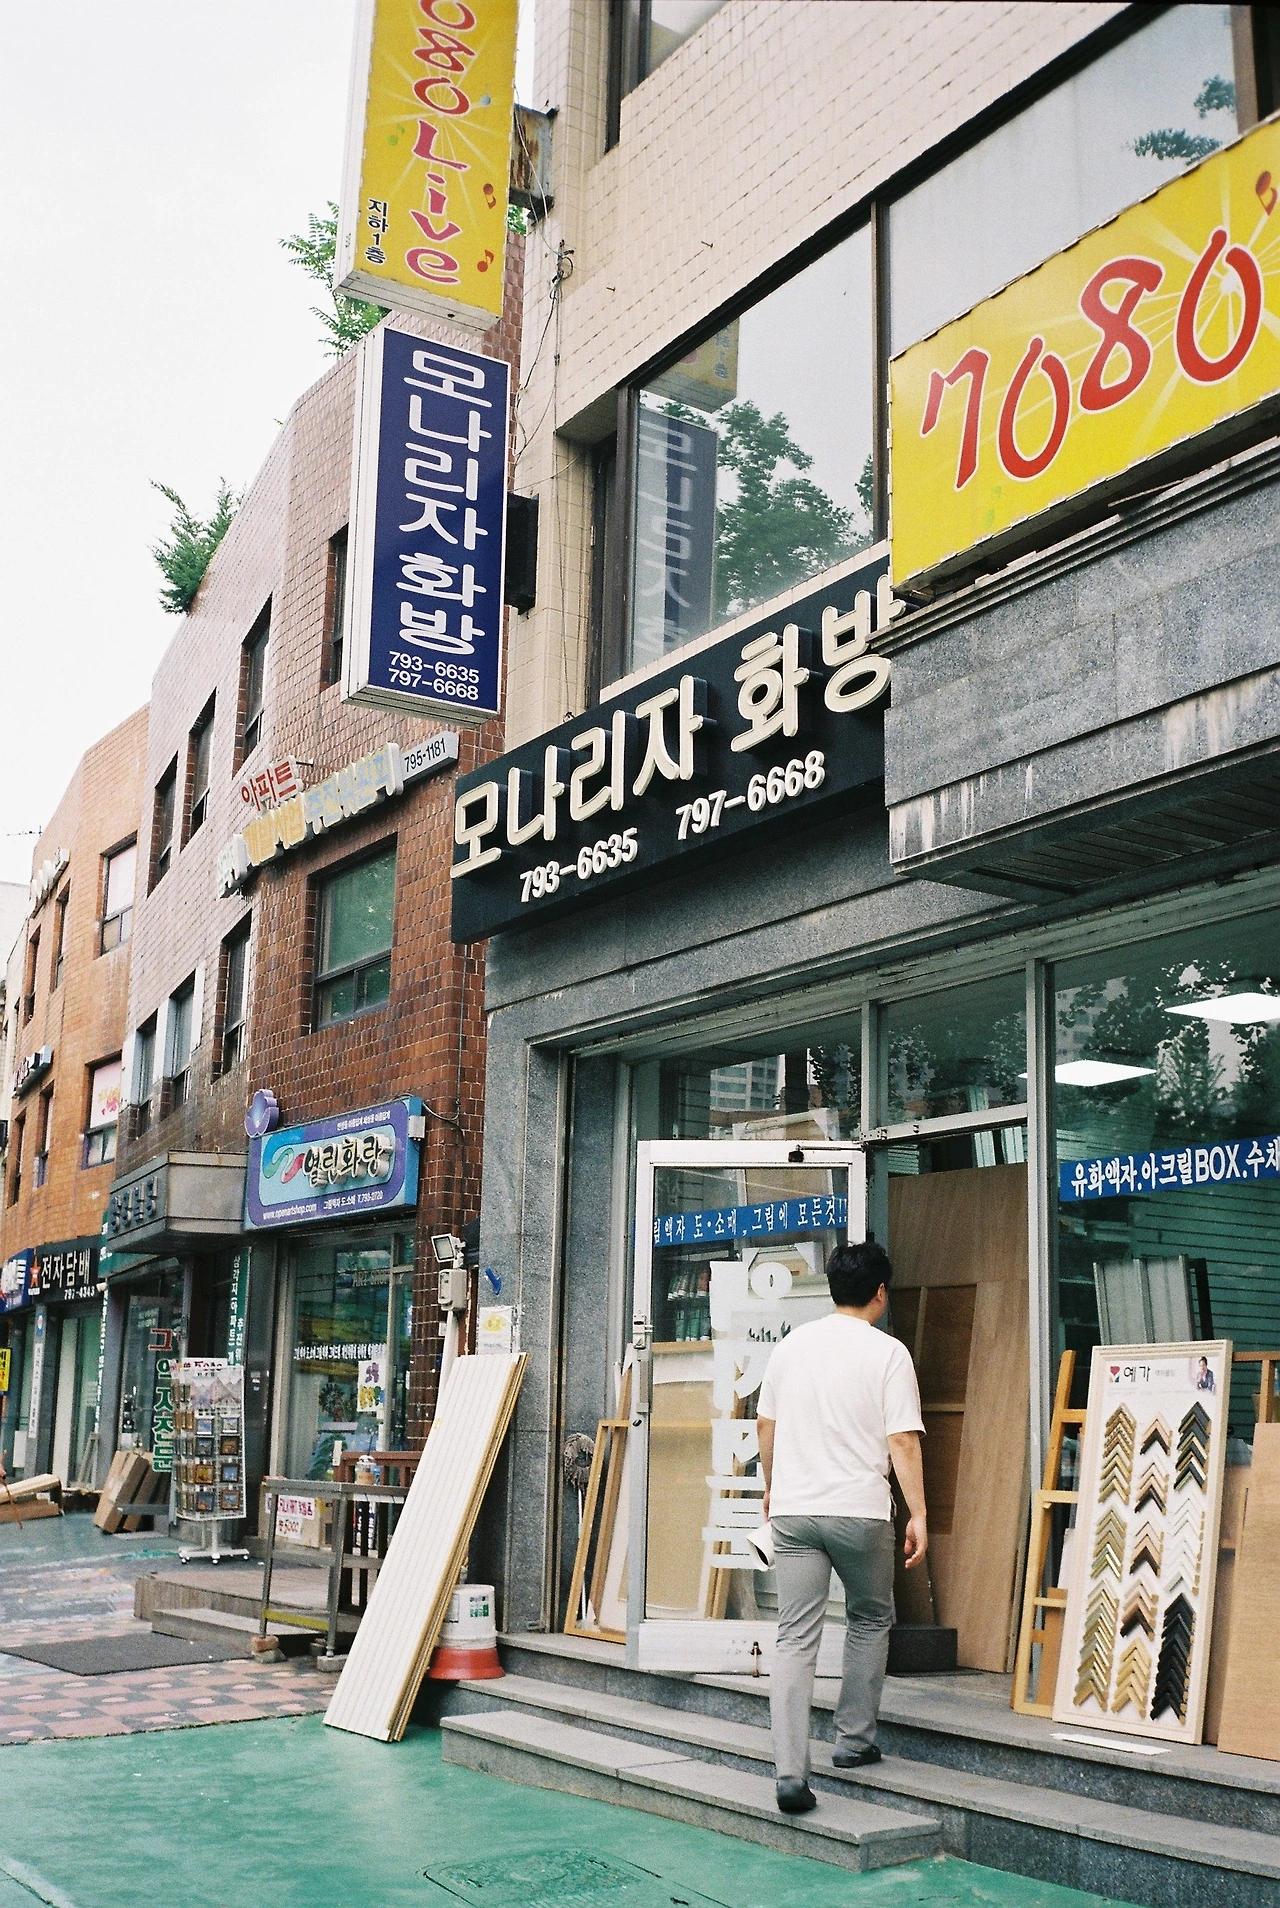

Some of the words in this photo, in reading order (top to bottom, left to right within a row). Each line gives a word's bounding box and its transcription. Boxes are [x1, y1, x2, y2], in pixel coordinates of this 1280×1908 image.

[364, 197, 389, 265] 지하1층
[920, 225, 1264, 491] 7080
[388, 667, 479, 701] 797-6668
[389, 650, 480, 684] 793-6635
[404, 737, 447, 773] 795-1181
[450, 674, 705, 880] 모나리자
[241, 760, 298, 812] 아파트
[519, 826, 639, 904] 793-6635
[675, 750, 826, 841] 797-6668
[303, 1133, 389, 1188] 열린화랑
[751, 1201, 789, 1232] 그림에
[40, 1248, 91, 1290] 전자담배
[1123, 1365, 1151, 1382] 예가
